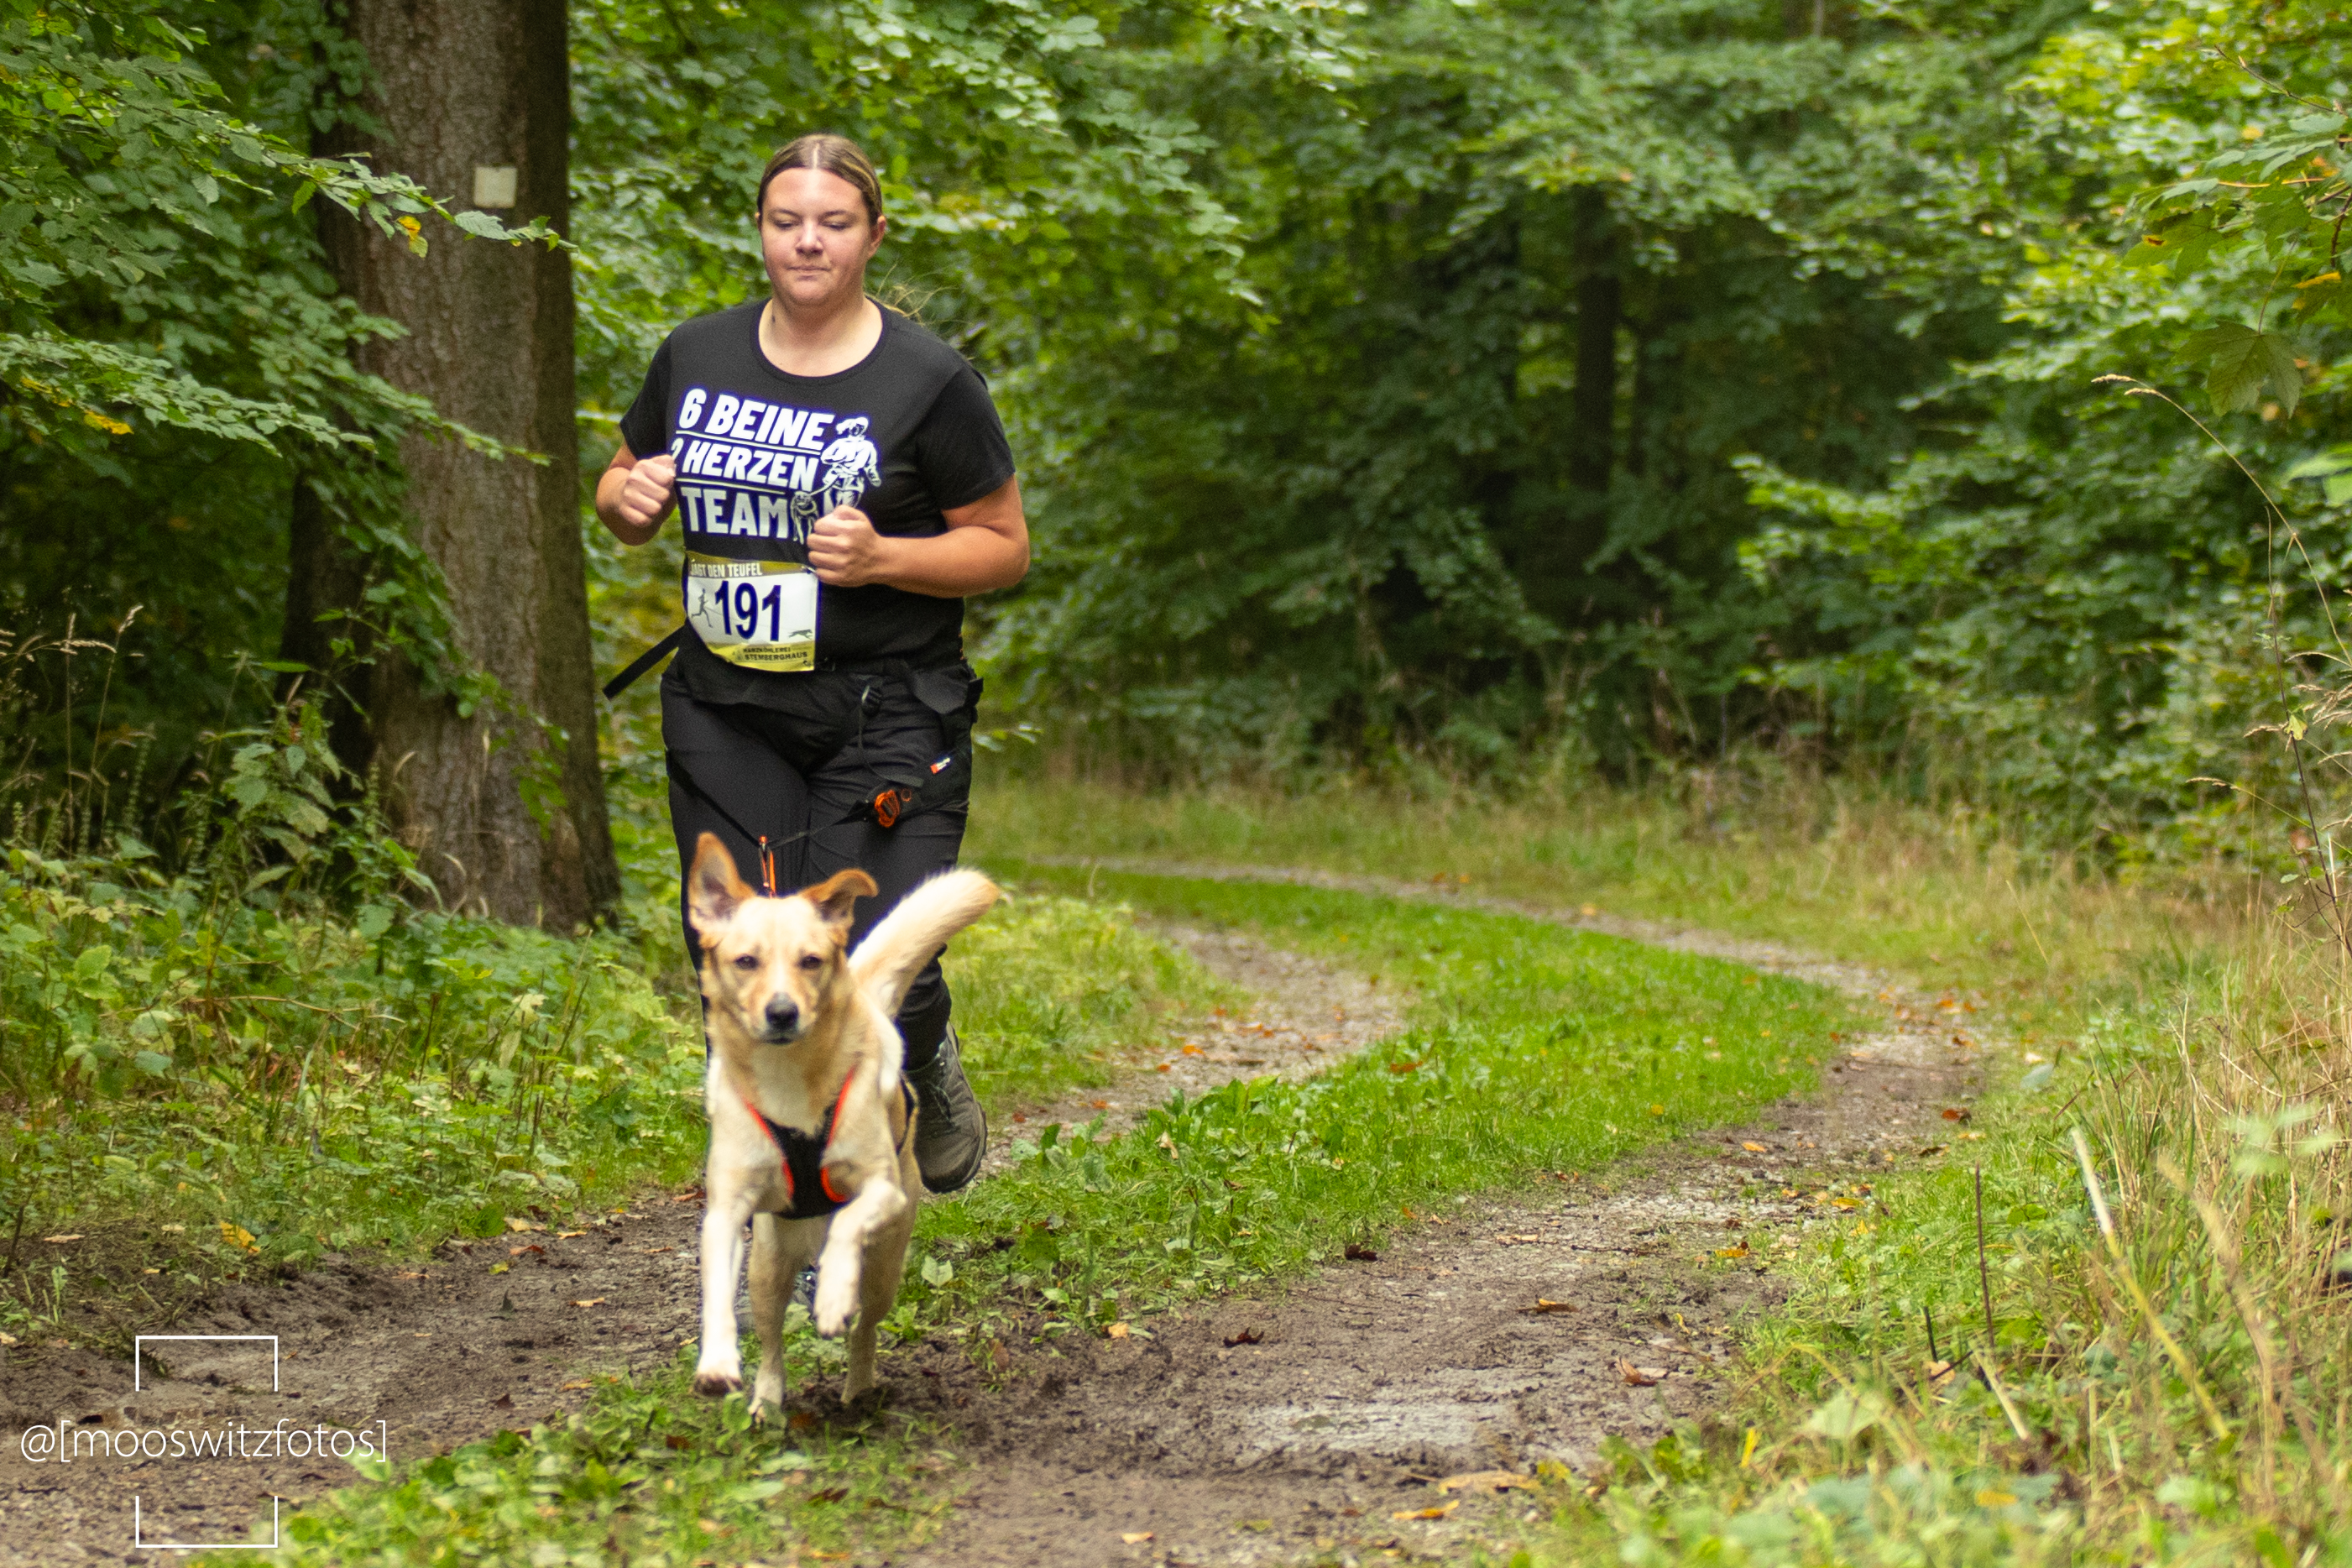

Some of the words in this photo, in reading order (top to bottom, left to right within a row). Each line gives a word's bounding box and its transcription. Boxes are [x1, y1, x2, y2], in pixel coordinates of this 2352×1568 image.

[678, 389, 707, 429] 6
[705, 395, 834, 450] BEINE
[682, 440, 821, 492] HERZEN
[681, 487, 788, 539] TEAM
[708, 563, 725, 578] DEN
[727, 562, 762, 578] TEUFEL
[715, 580, 781, 642] 191
[745, 651, 808, 661] STEMBERGHAUS
